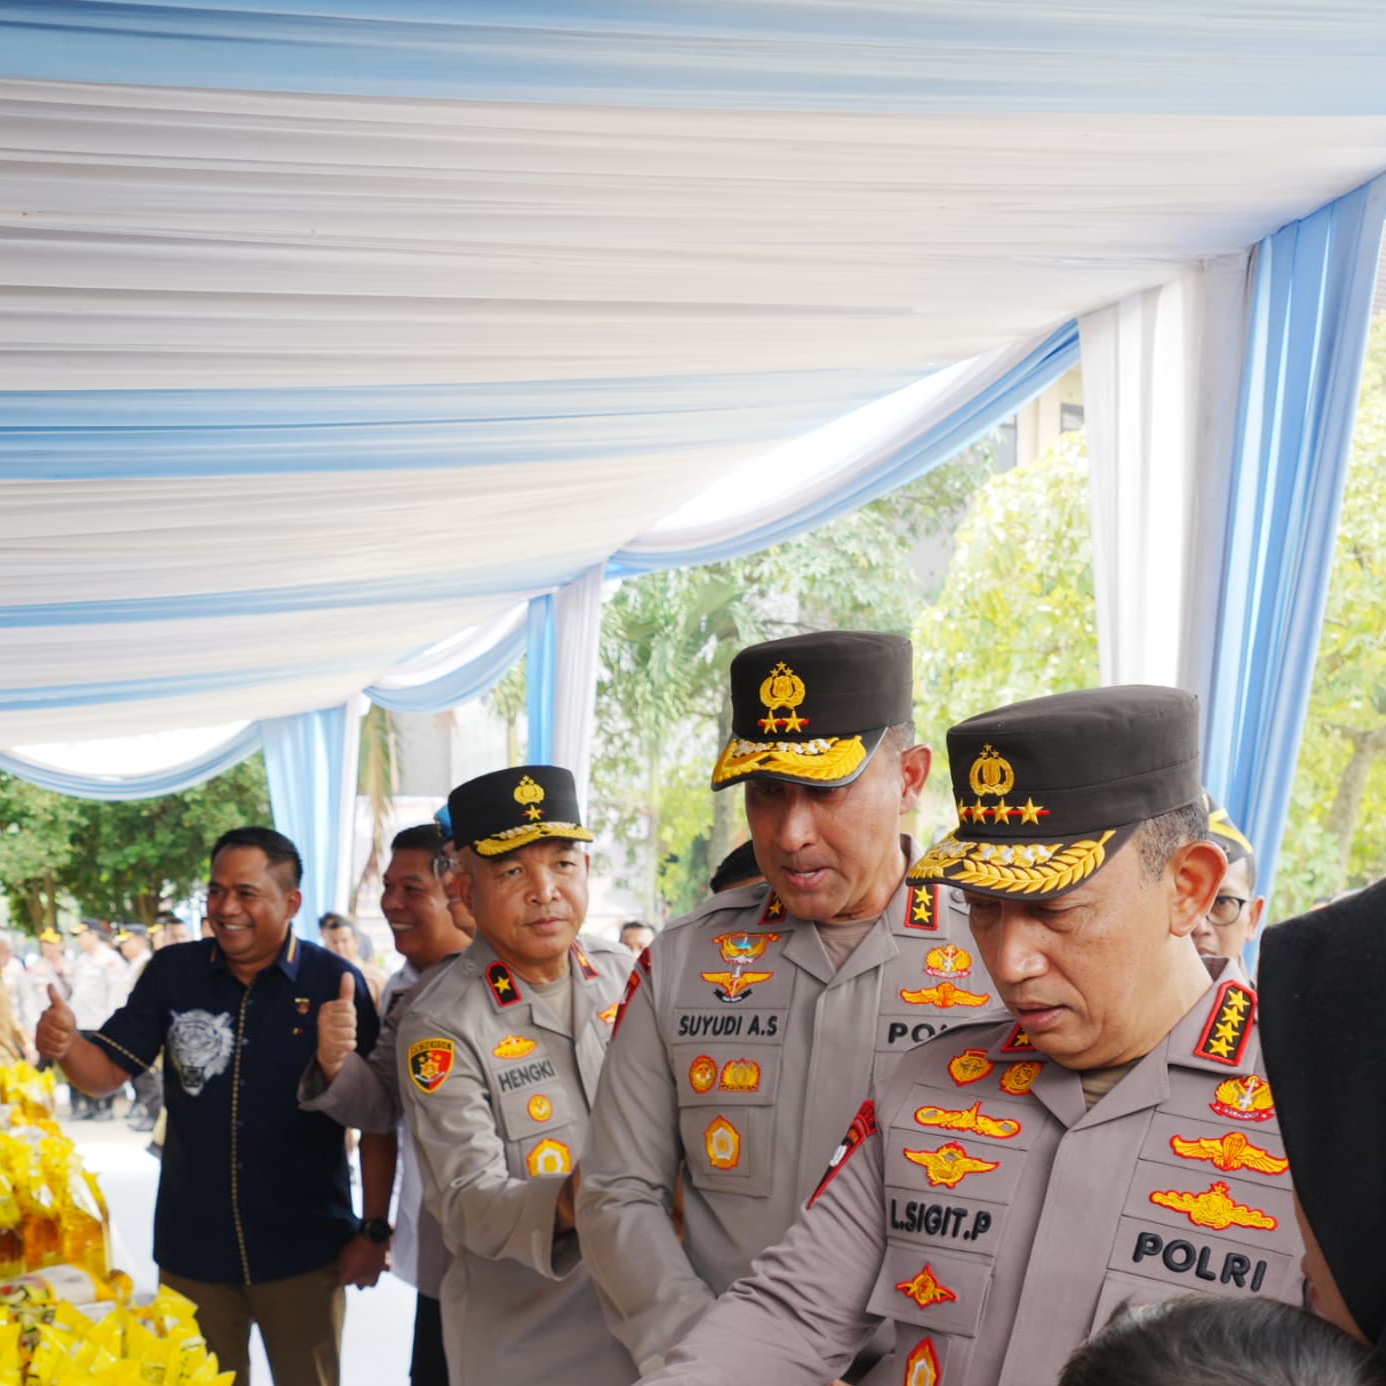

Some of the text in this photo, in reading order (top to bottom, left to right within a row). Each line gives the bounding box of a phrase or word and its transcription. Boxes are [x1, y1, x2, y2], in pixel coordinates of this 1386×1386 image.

[678, 1014, 778, 1037] SUYUDI A.S
[498, 1060, 556, 1092] HENGKI
[890, 1198, 992, 1241] L.SIGIT.P
[1132, 1232, 1268, 1293] POLRI
